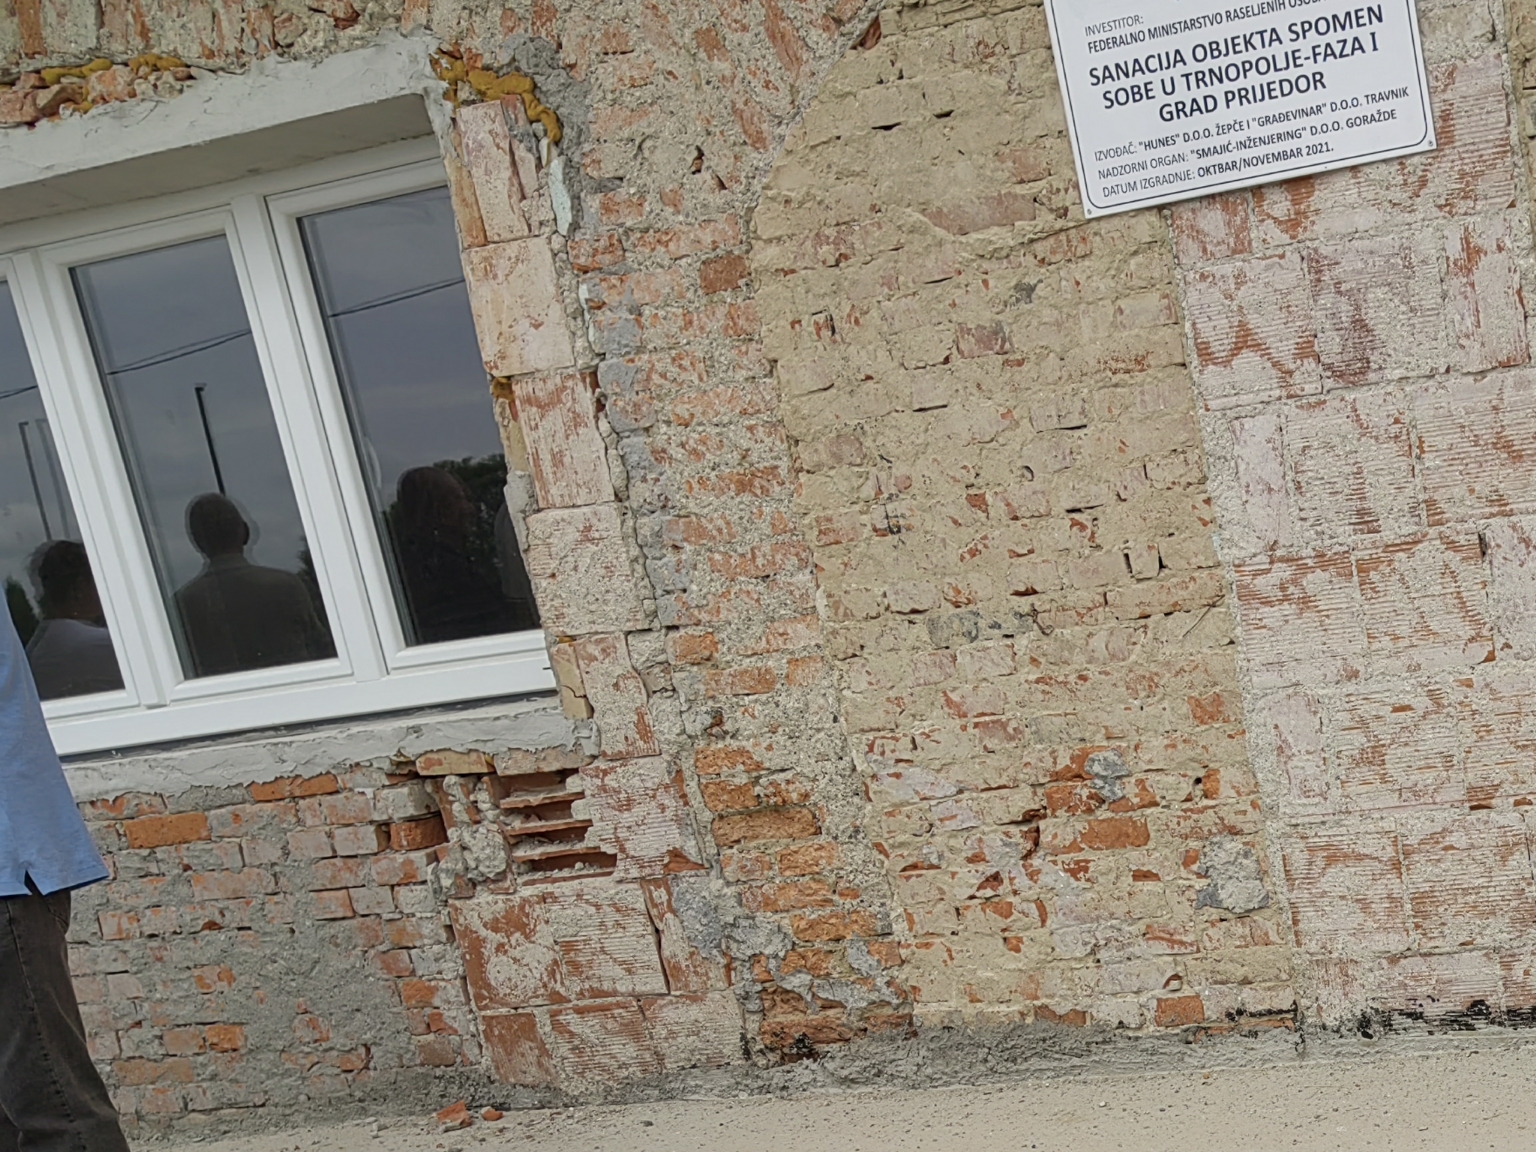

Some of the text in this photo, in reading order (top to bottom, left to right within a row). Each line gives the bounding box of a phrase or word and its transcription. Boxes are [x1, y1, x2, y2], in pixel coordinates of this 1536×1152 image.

[1085, 14, 1144, 37] INVESTITOR:
[1087, 0, 1287, 54] FEDERALNO MINISTARSTVO RASELJENIH
[1089, 3, 1384, 86] SANACIJA OBJEKTA SPOMEN
[1103, 31, 1379, 109] SOBE U TRNOPOLJE-FAZA I
[1159, 71, 1327, 122] GRAD PRIJEDOR
[1094, 141, 1138, 162] IZVOĐAČ:
[1138, 133, 1180, 151] "HUNES"
[1183, 127, 1214, 143] D.O.O.
[1215, 118, 1245, 136] ŽEPČE
[1251, 102, 1327, 128] "GRAĐEVINAR"
[1330, 96, 1363, 113] D.O.O.
[1364, 86, 1410, 106] TRAVNIK
[1098, 160, 1149, 181] NADZORNI
[1149, 152, 1189, 170] ORGAN:
[1310, 120, 1344, 137] D.O.O.
[1345, 109, 1398, 129] GORAŽDE
[1102, 141, 1334, 198] DATUM IZGRADNJE: OKTBAR/NOVEMBAR 2021.
